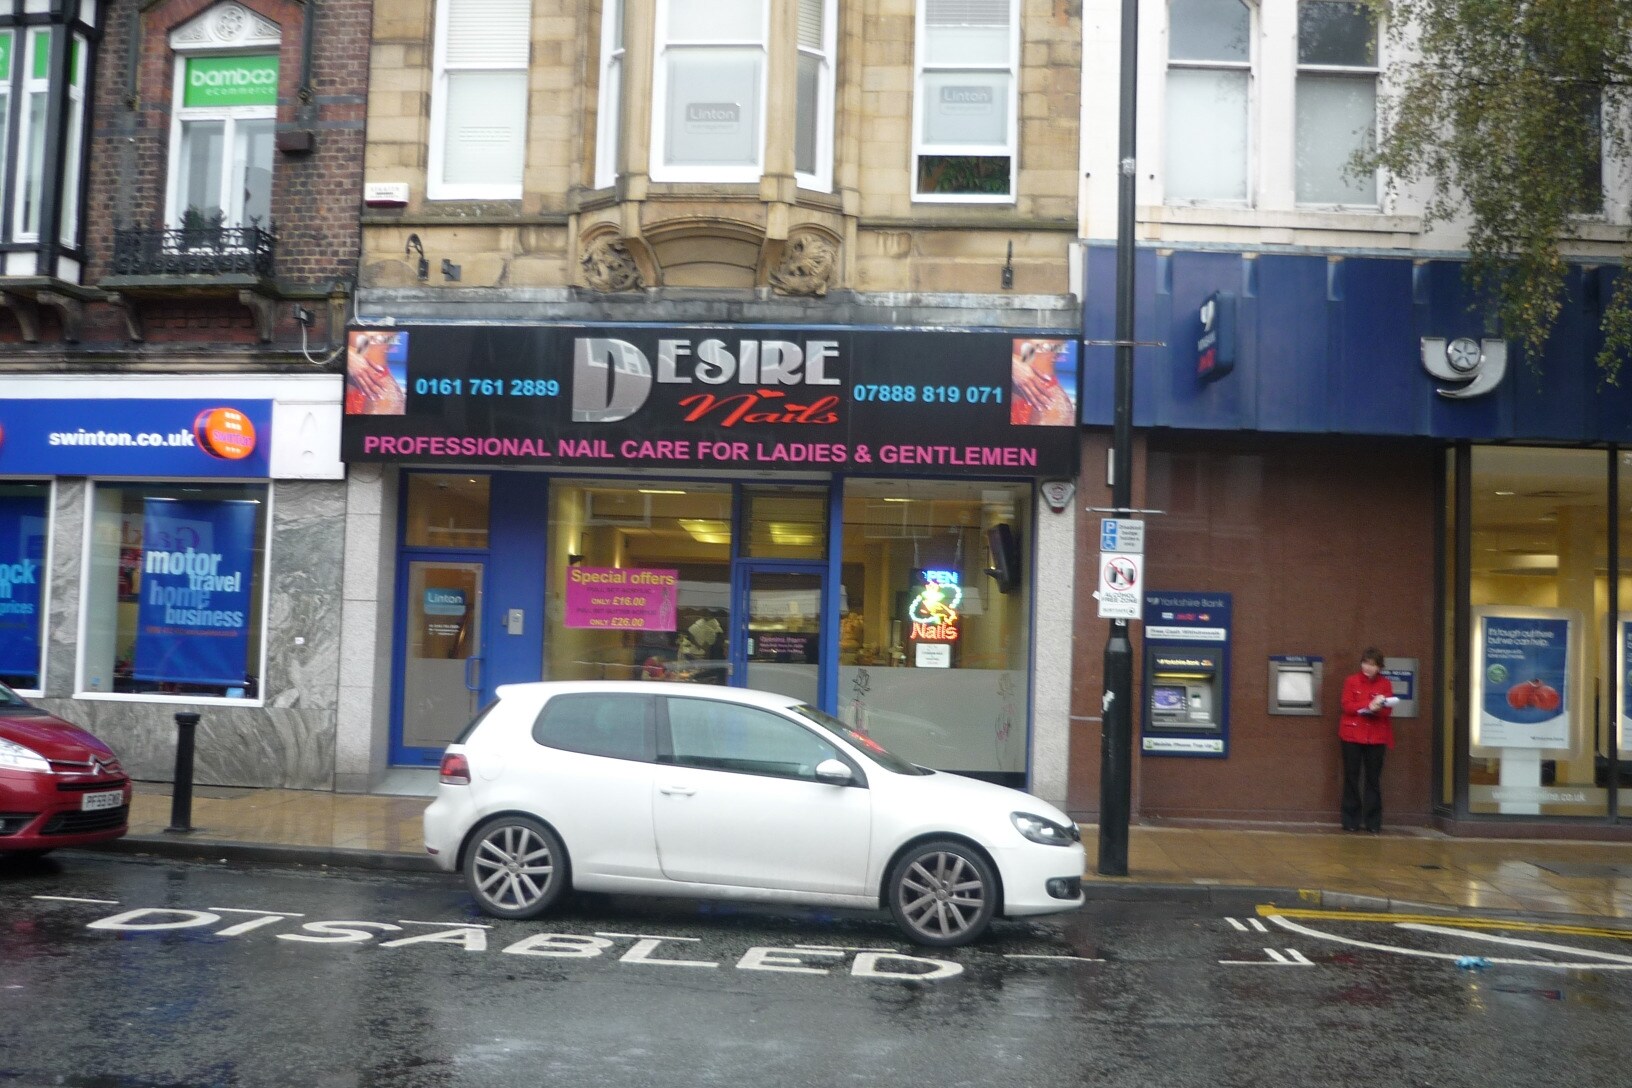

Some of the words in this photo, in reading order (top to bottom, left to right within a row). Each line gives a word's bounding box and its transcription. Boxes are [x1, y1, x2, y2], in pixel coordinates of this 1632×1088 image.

[191, 68, 276, 86] bamboo
[415, 378, 462, 395] 0161
[469, 379, 504, 396] 761
[510, 379, 560, 397] 2889
[853, 385, 916, 402] 07888
[922, 386, 960, 404] 819
[966, 386, 1003, 404] 071
[678, 388, 841, 428] Nails
[49, 429, 195, 447] swinton.co.uk
[364, 436, 551, 458] PROFESSIONAL
[558, 439, 614, 459] NAIL
[621, 441, 690, 460] CARE
[697, 441, 749, 461] FOR
[756, 443, 847, 463] LADIES
[854, 445, 873, 464] &
[879, 446, 1037, 467] GENTLEMEN
[145, 547, 223, 576] motor
[189, 571, 241, 593] travel
[571, 569, 626, 585] Special
[630, 571, 676, 586] offers
[149, 580, 211, 609] home
[427, 592, 463, 604] Linton
[613, 596, 646, 606] £16.00
[1160, 598, 1200, 607] Yorkshire
[1202, 599, 1224, 607] Bank
[165, 604, 244, 627] business
[910, 621, 958, 639] Nails
[86, 907, 964, 980] DISABLED
